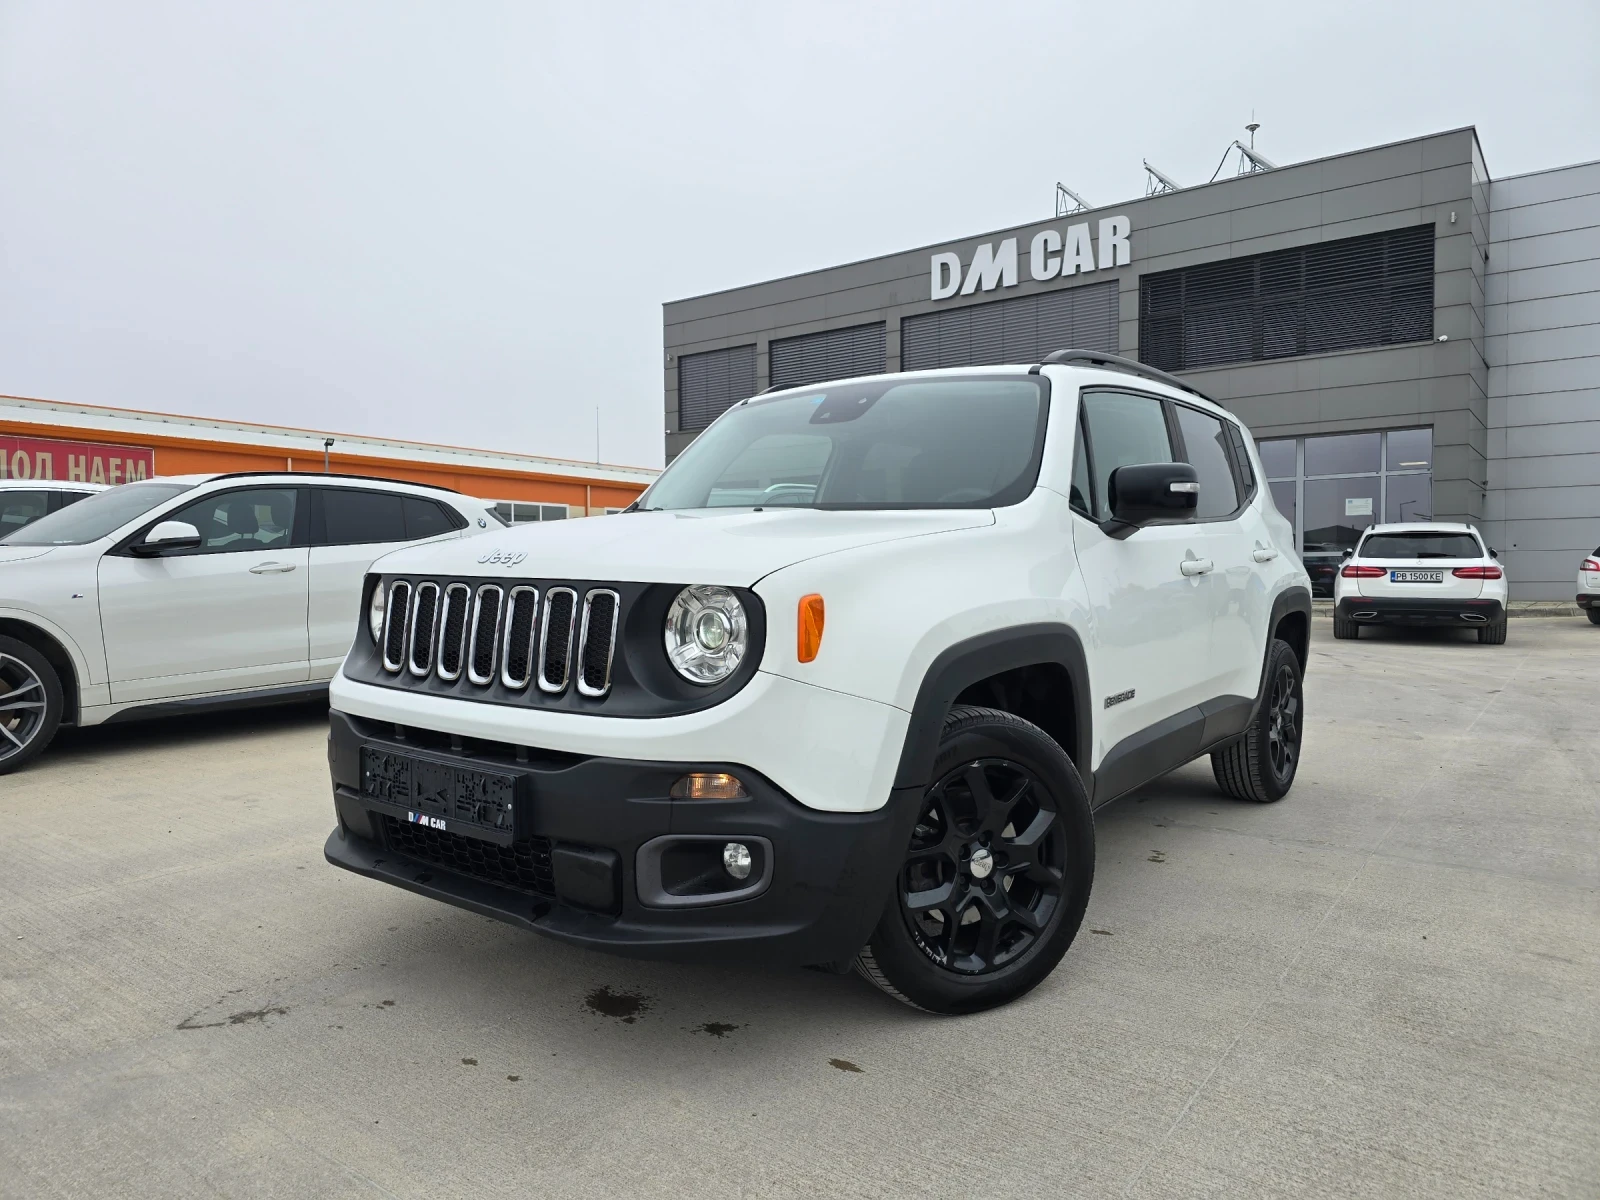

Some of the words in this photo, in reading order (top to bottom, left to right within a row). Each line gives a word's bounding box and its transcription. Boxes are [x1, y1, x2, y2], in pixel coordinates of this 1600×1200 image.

[931, 237, 1018, 301] DM
[1030, 215, 1131, 281] CAR
[68, 454, 147, 486] НАЕМ
[477, 548, 528, 568] Jeep
[1396, 572, 1407, 581] PB
[1409, 572, 1429, 581] 1500
[1430, 572, 1441, 581] KE
[430, 817, 446, 831] CAR
